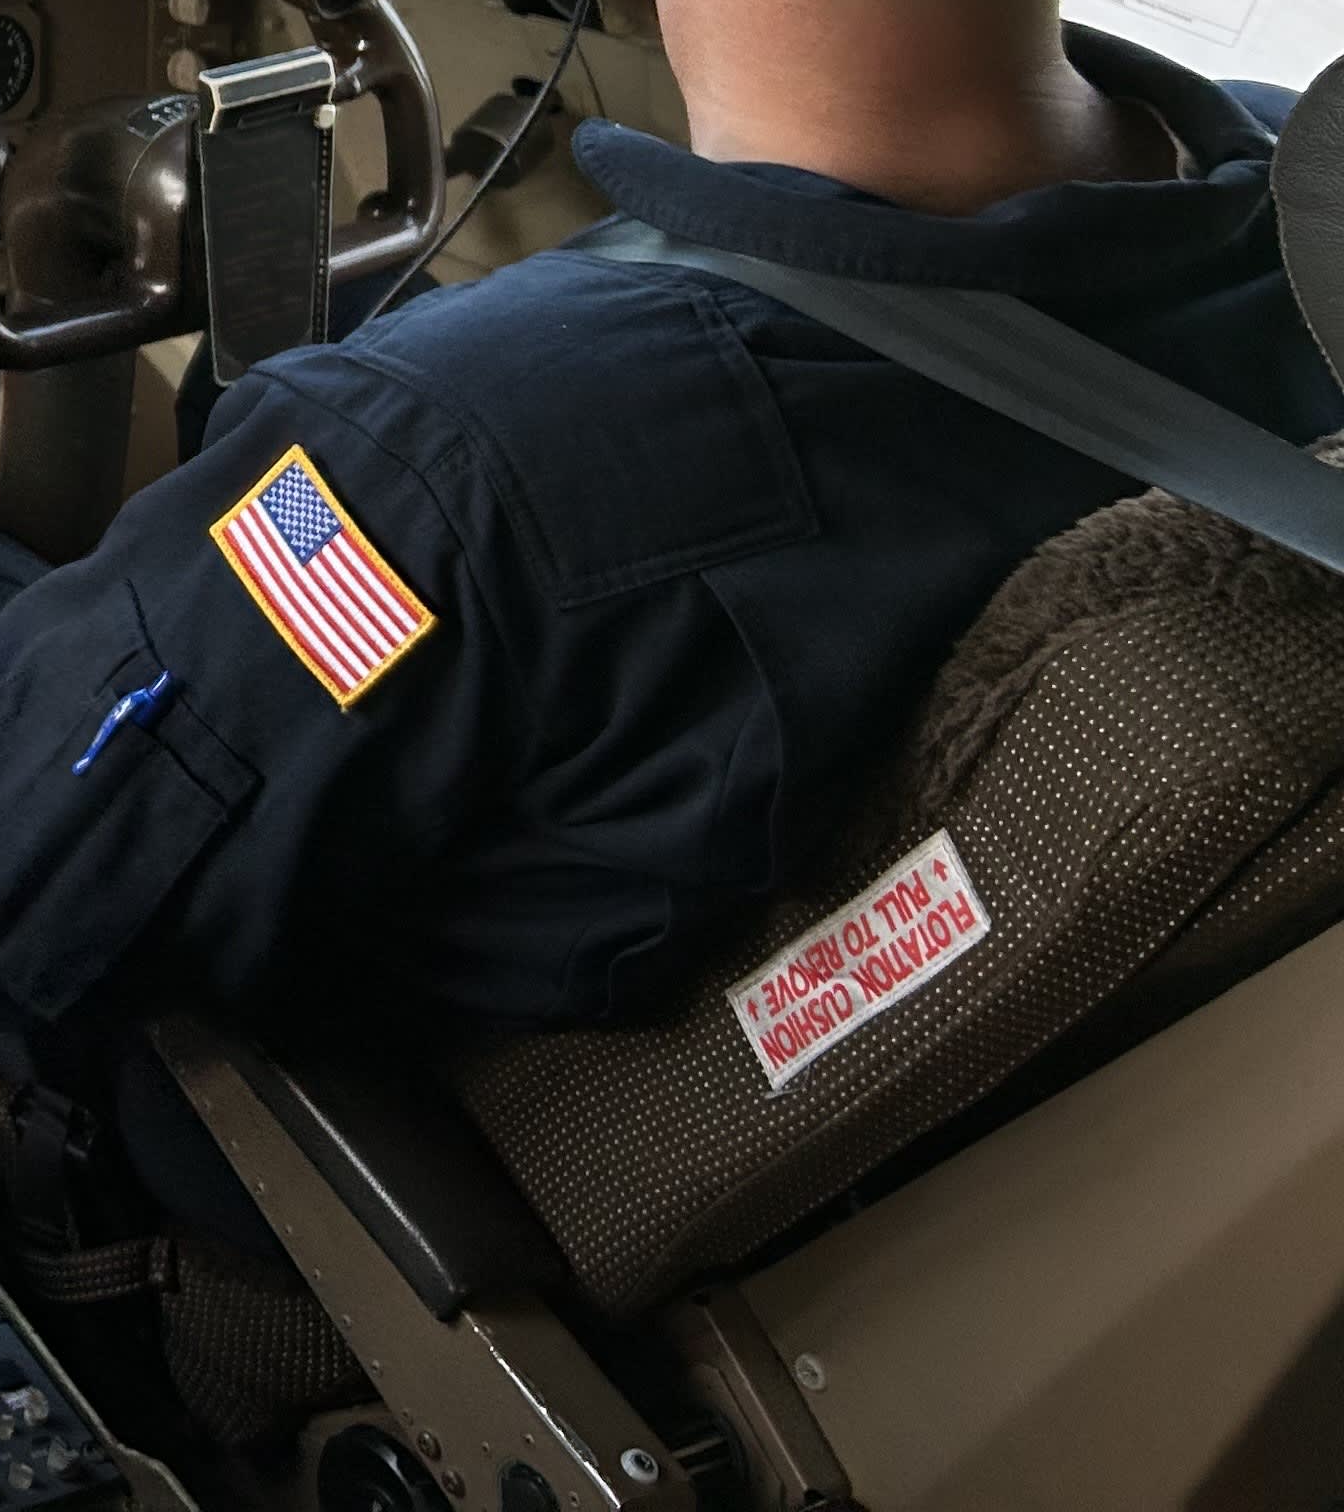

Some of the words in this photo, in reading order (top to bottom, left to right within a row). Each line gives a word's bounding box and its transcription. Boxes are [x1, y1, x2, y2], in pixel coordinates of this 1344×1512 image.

[843, 913, 880, 957] TO
[873, 870, 931, 932] PULL
[761, 934, 845, 1017] REMOVE
[850, 890, 976, 1003] FLOTATION
[760, 983, 853, 1070] CUSHION
